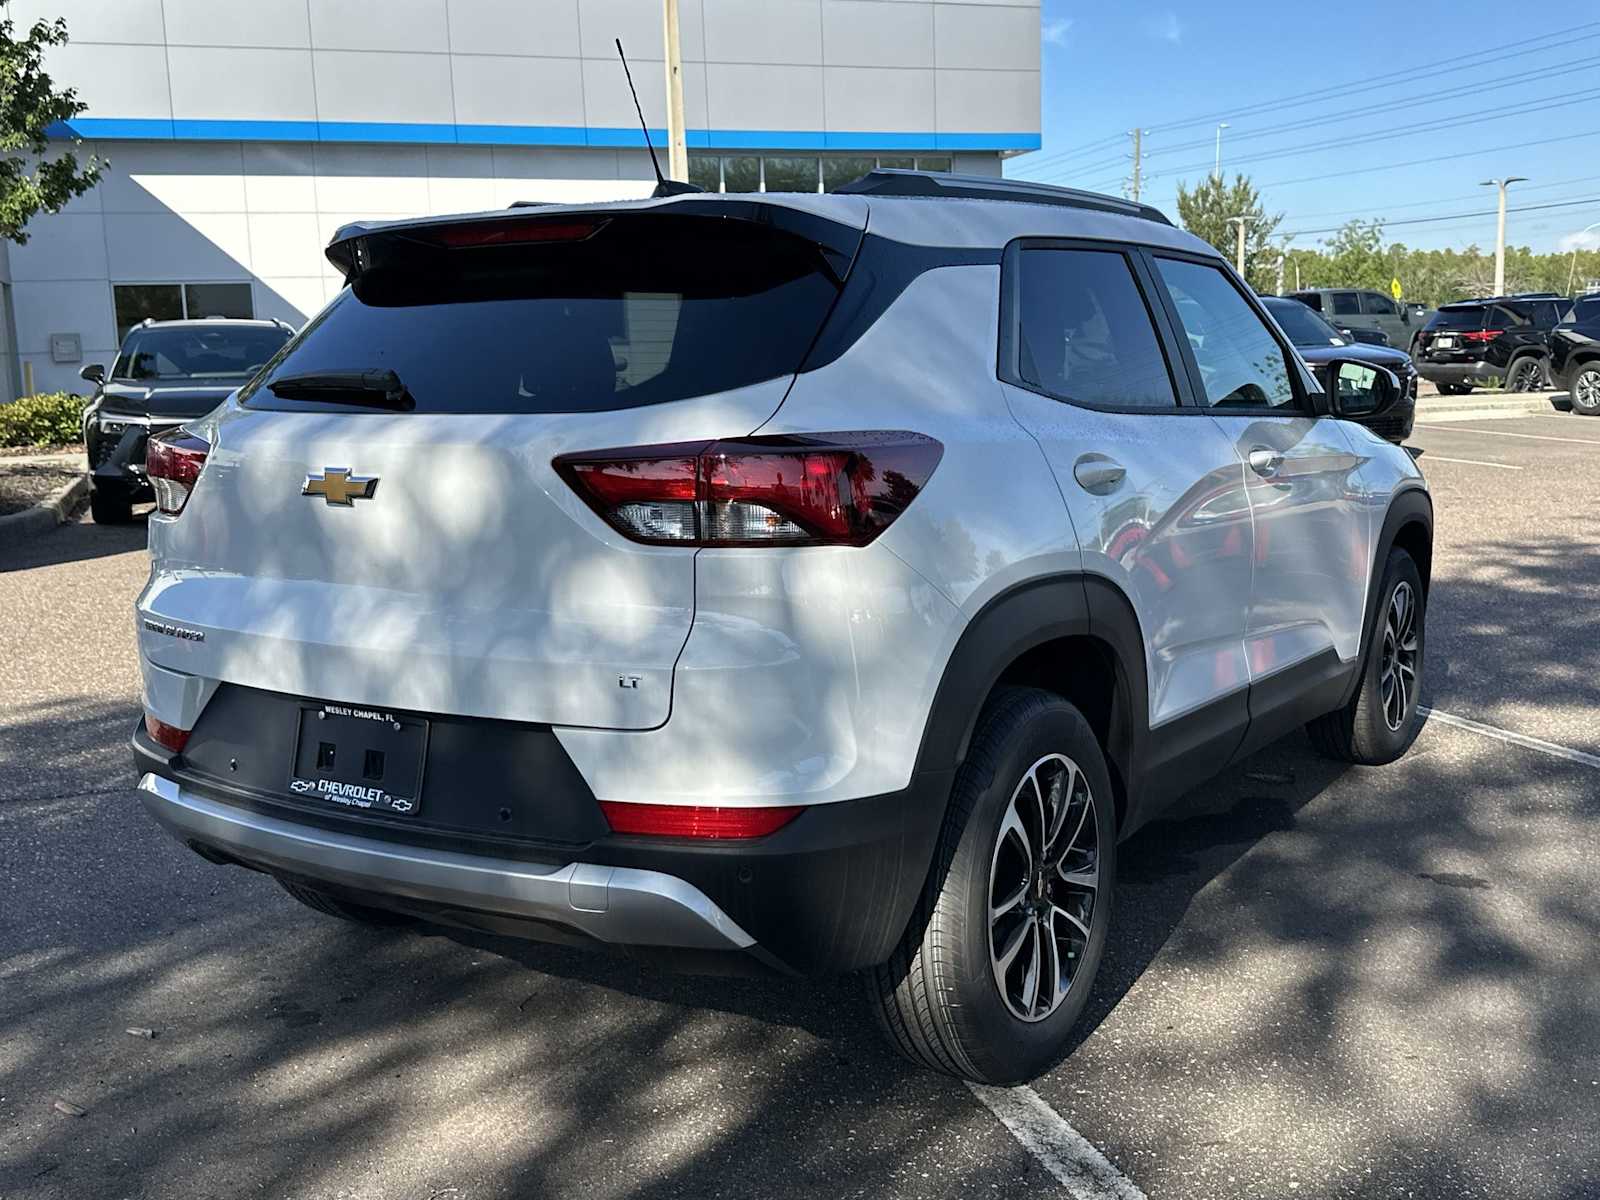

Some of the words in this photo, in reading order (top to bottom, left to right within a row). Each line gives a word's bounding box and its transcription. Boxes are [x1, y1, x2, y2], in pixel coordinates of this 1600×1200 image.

[619, 673, 642, 688] LT
[324, 705, 352, 716] WESLEY
[353, 709, 384, 721] CHAPEL,
[385, 713, 395, 722] FL
[318, 779, 384, 802] CHEVROLET
[331, 795, 351, 806] Wesley
[350, 798, 371, 808] Chapel
